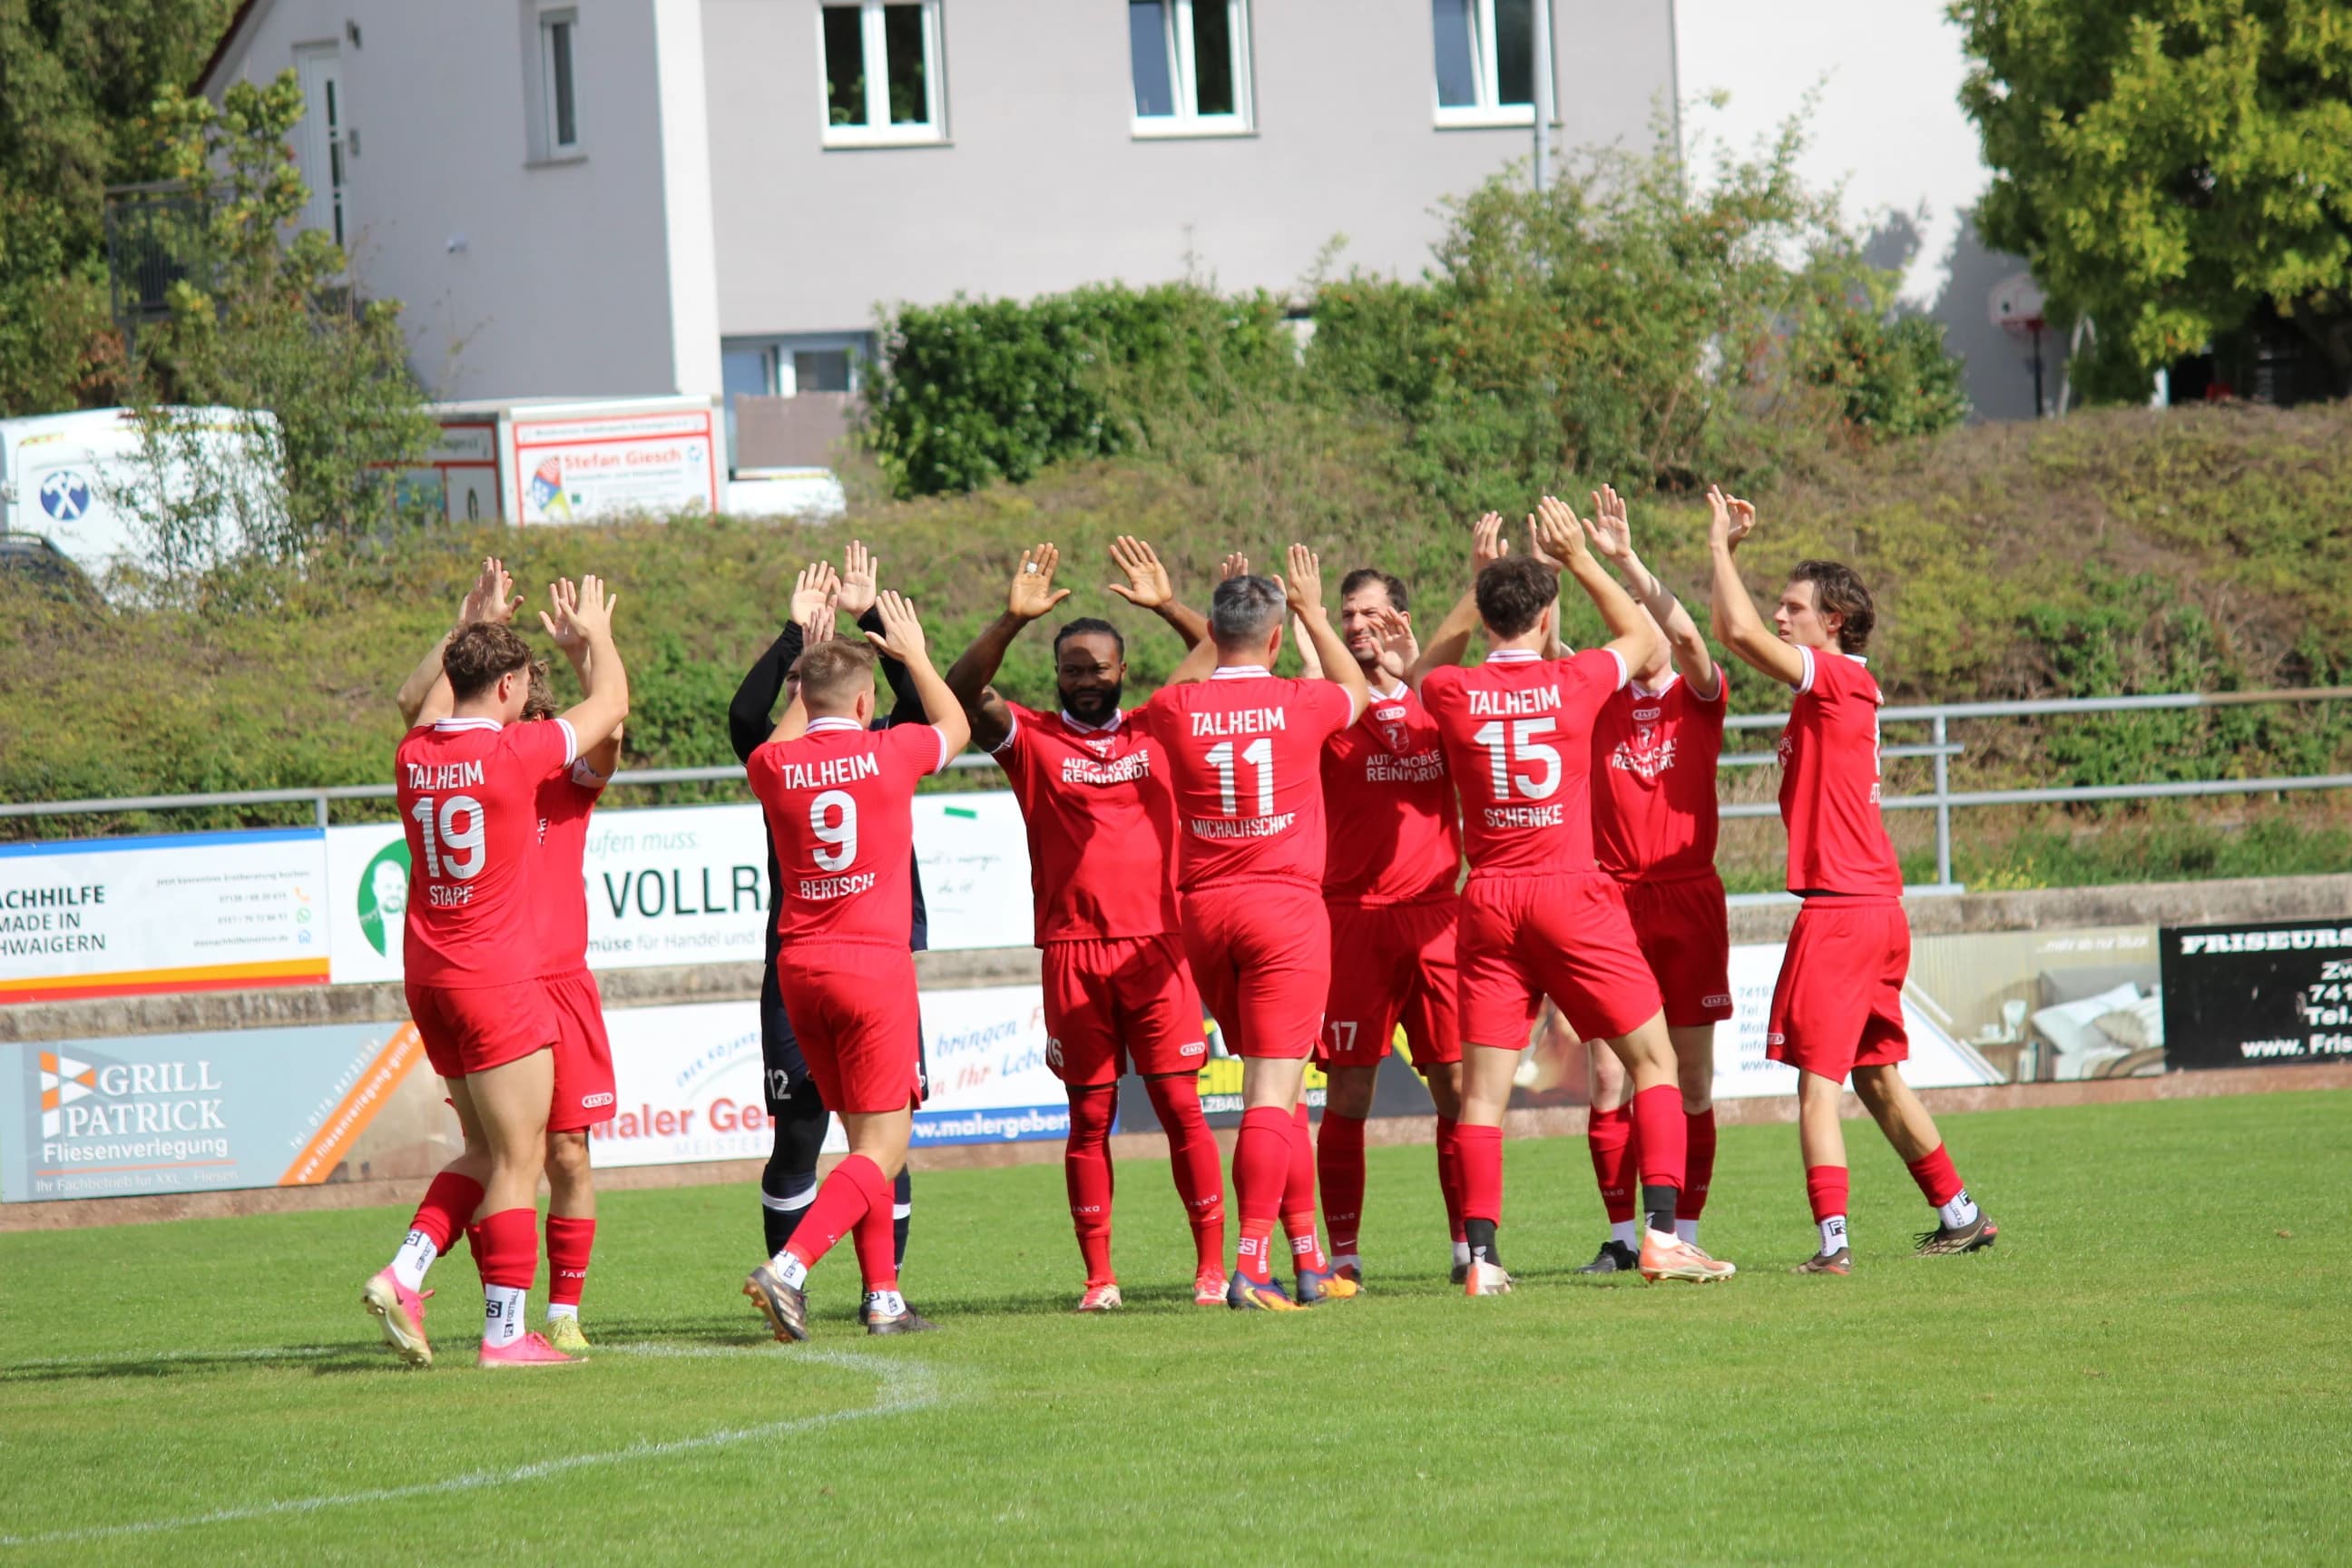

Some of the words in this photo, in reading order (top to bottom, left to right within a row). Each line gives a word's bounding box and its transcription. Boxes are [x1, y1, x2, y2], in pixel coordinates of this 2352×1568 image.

[564, 453, 620, 470] Stefan
[625, 448, 681, 466] Giesch
[1466, 684, 1562, 715] TALHEIM
[1191, 706, 1287, 737] TALHEIM
[781, 751, 880, 790] TALHEIM
[1062, 763, 1150, 784] REINHARDT
[1473, 716, 1562, 800] 15
[406, 760, 485, 790] TALHEIM
[1204, 738, 1273, 818] 11
[809, 789, 858, 873] 9
[1191, 812, 1297, 839] MICHALITSCHKE
[1484, 804, 1564, 828] SCHENKE
[411, 795, 486, 879] 19
[428, 884, 475, 907] STAPF
[602, 864, 771, 920] VOLLR
[799, 872, 876, 901] BERTSCH
[59, 912, 81, 929] IN
[637, 932, 659, 950] für
[664, 930, 720, 948] Handel
[723, 930, 756, 946] und
[2303, 1005, 2352, 1026] Tel.
[936, 1018, 1017, 1059] bringen
[1047, 1035, 1064, 1068] 16
[1330, 1020, 1358, 1052] 17
[2239, 1038, 2305, 1059] www.
[100, 1060, 223, 1097] GRILL
[767, 1068, 792, 1101] 12
[956, 1063, 992, 1090] Ihr
[65, 1098, 226, 1138] PATRICK
[709, 1096, 776, 1133] Ge
[43, 1137, 229, 1164] Fliesenverlegung
[36, 1178, 54, 1194] Ihr
[57, 1174, 132, 1191] Fachbetrieb
[193, 1169, 240, 1184] Fliesen
